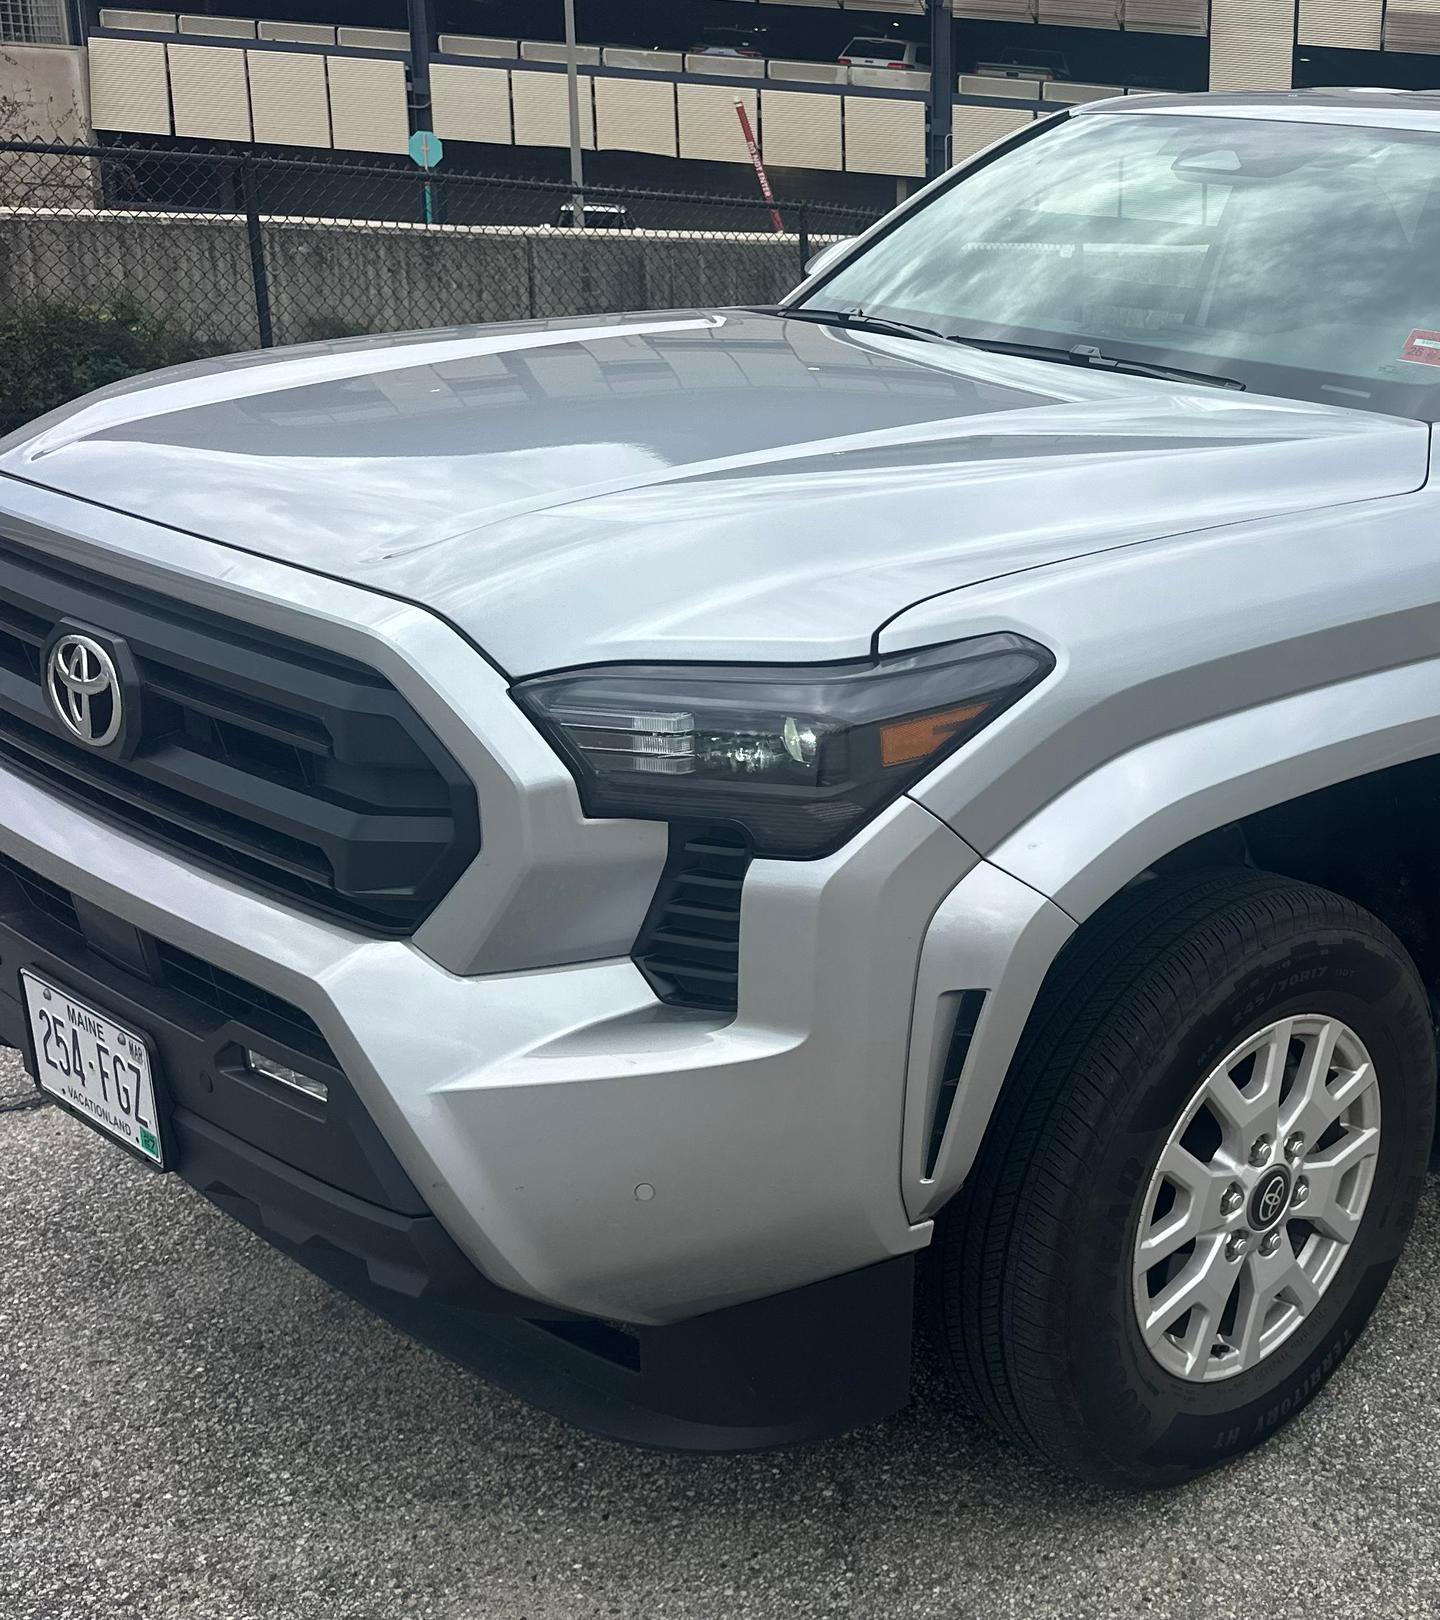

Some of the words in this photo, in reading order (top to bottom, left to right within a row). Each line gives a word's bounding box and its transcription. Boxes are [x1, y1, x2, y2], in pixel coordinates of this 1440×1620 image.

[747, 141, 756, 154] DO
[757, 172, 772, 197] ENTER
[67, 1004, 106, 1042] MAINE
[128, 1041, 144, 1060] MAR
[67, 1086, 132, 1137] VACATIONLAND
[1252, 1329, 1353, 1436] TERRITORY
[1212, 1426, 1241, 1449] HT
